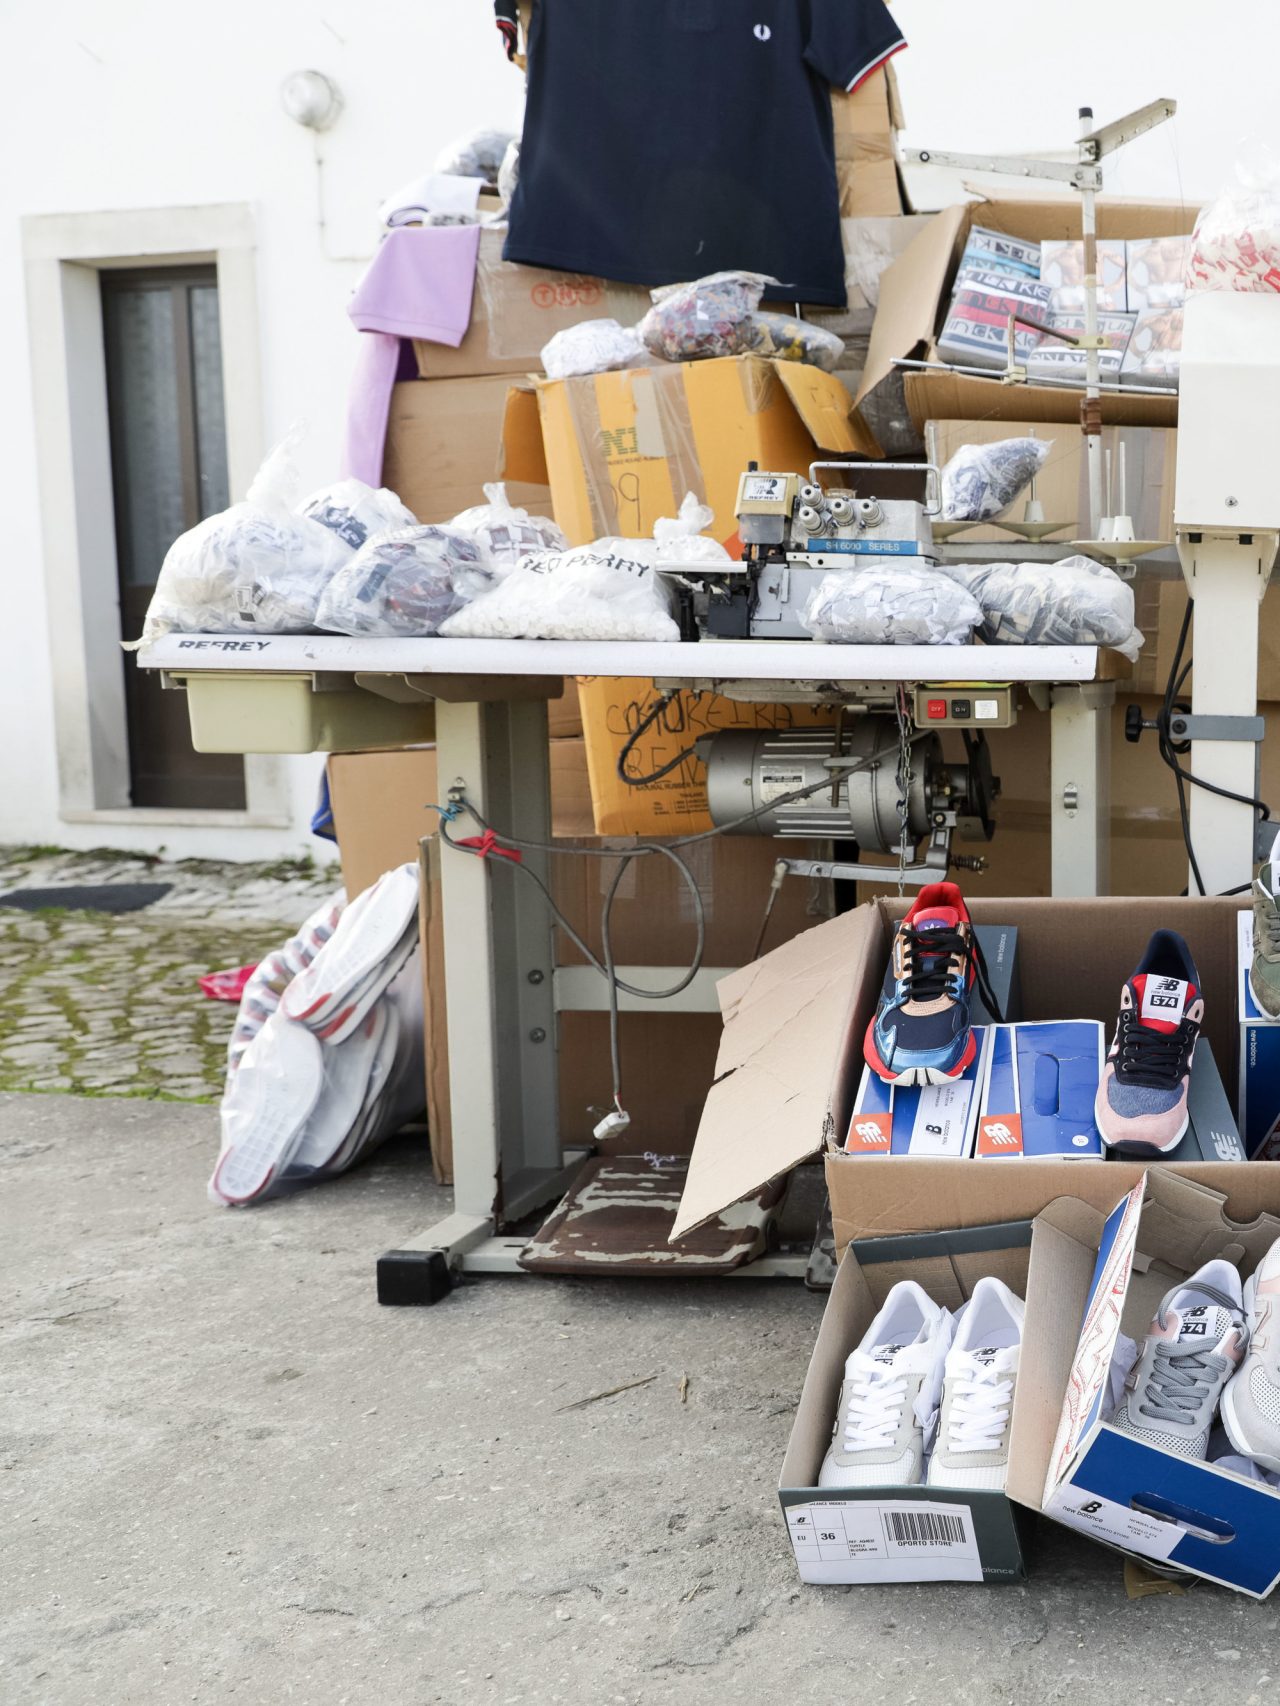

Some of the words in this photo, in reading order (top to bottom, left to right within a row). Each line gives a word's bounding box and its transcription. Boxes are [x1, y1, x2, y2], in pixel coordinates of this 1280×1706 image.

[840, 541, 862, 550] 6000
[868, 543, 900, 551] SERIES
[523, 557, 563, 574] RED
[566, 554, 649, 577] PERRY
[178, 640, 271, 651] REFREY
[1152, 996, 1176, 1007] 574
[1062, 1505, 1076, 1514] new
[1076, 1509, 1104, 1523] balance
[820, 1532, 836, 1540] 36
[982, 1567, 1015, 1575] alance
